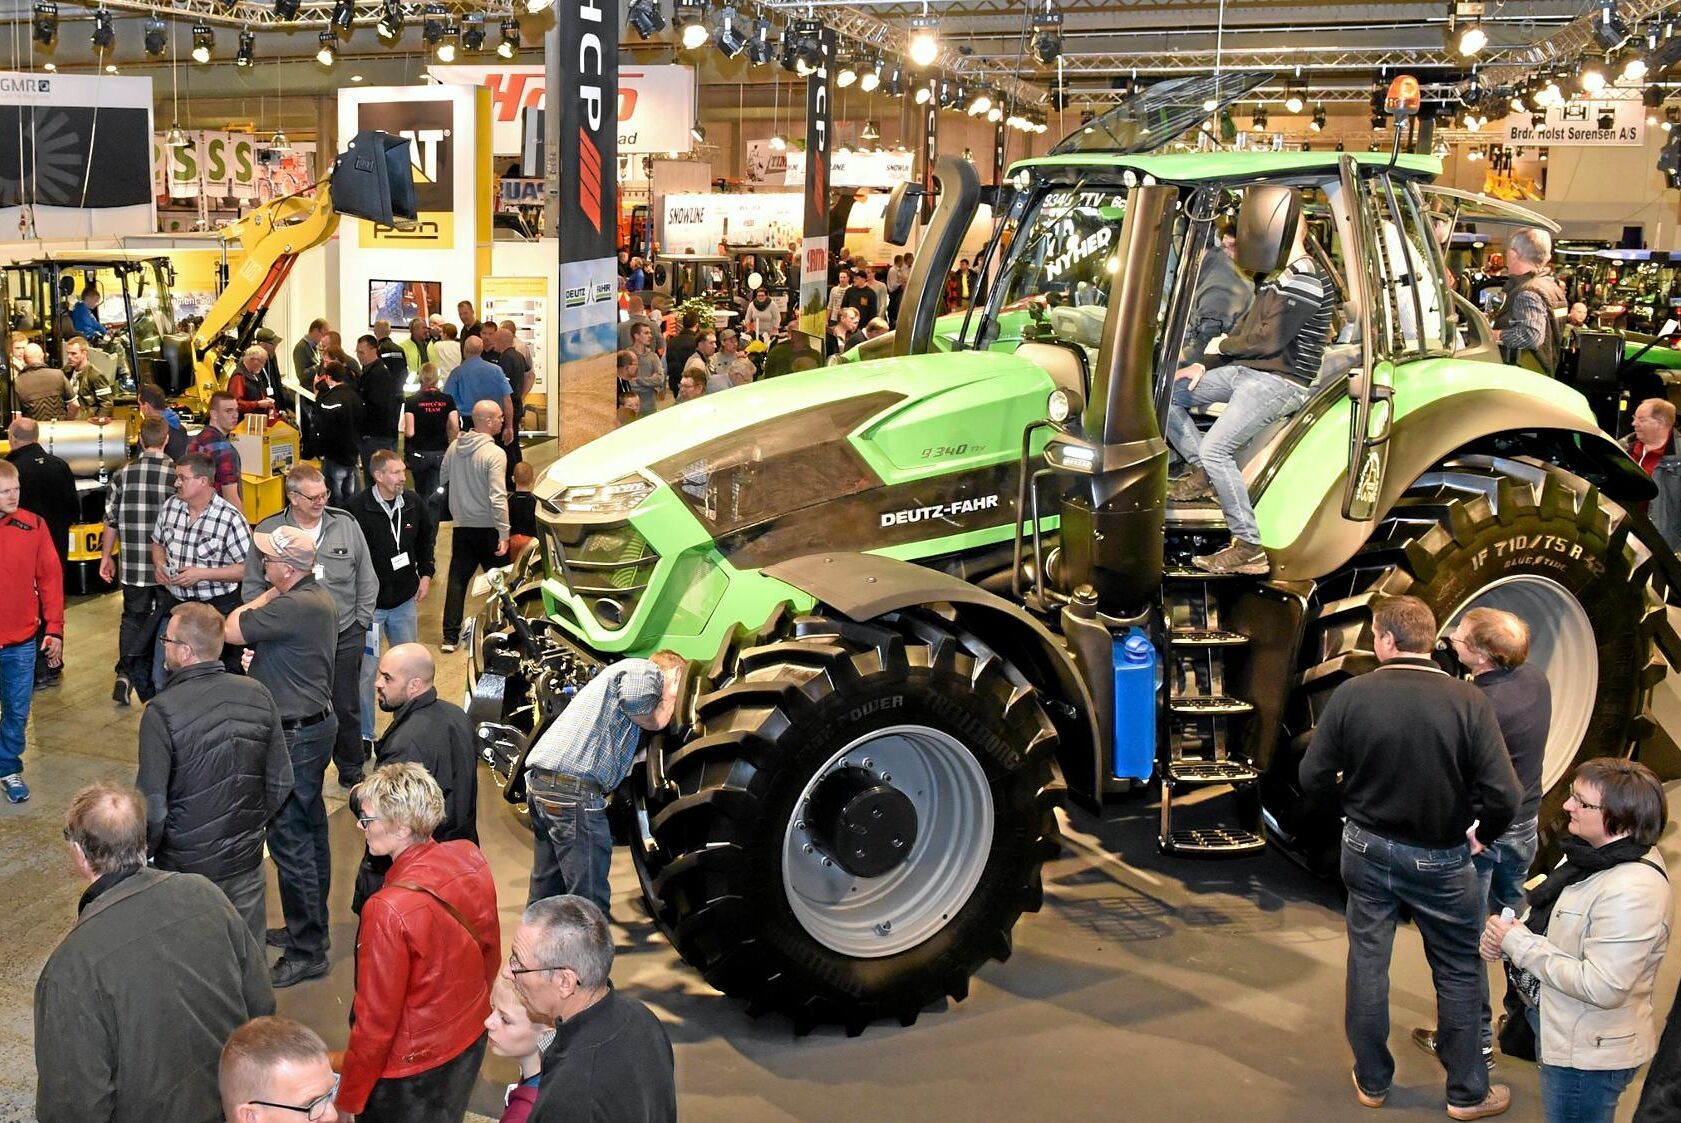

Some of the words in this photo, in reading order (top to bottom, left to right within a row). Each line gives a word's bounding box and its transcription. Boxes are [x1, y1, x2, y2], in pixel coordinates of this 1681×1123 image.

[0, 79, 36, 92] GMR
[1510, 127, 1535, 140] Brdr.
[1567, 127, 1616, 140] Sørensen
[668, 207, 705, 225] SNOWLINE
[880, 494, 999, 528] DEUTZ-FAHR
